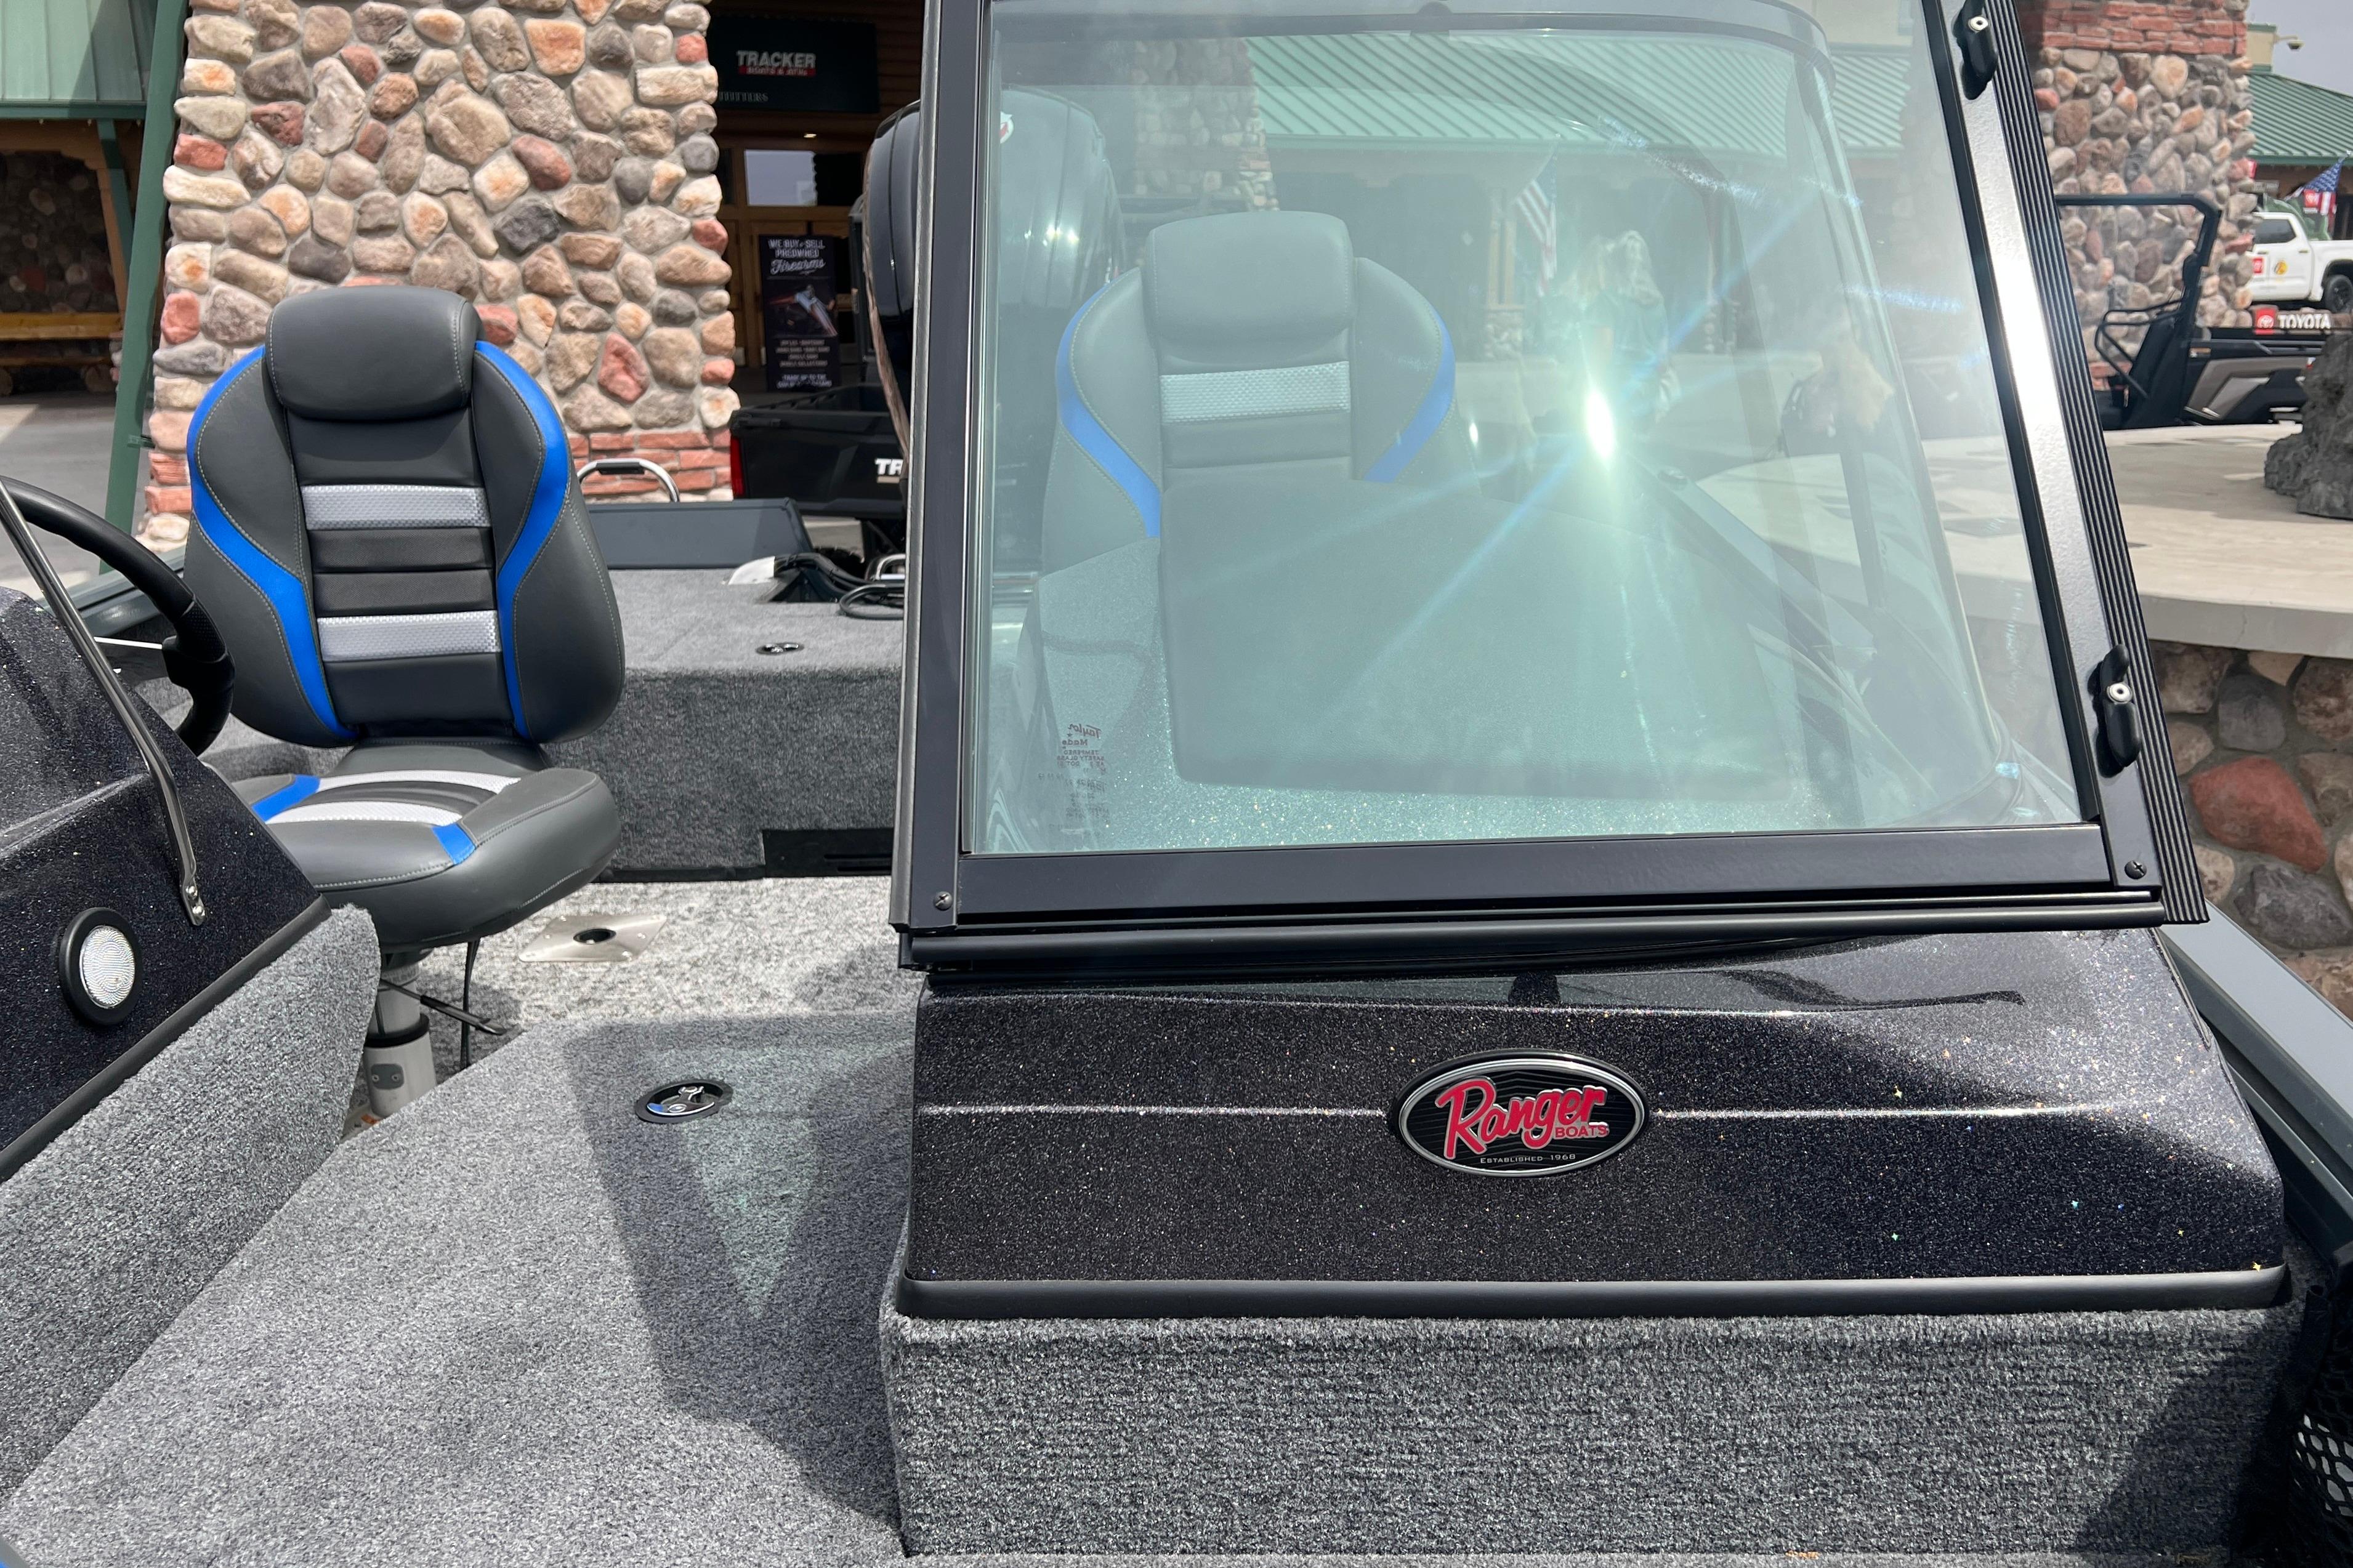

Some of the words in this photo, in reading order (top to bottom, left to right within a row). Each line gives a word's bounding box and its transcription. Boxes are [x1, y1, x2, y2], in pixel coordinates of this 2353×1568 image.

[737, 50, 817, 68] TRACKER
[768, 239, 783, 249] WE
[783, 239, 799, 247] BUY
[806, 239, 825, 249] SELL
[2277, 313, 2331, 329] TOYOTA
[1435, 1076, 1608, 1160] Ranger
[1555, 1124, 1608, 1139] BOATS
